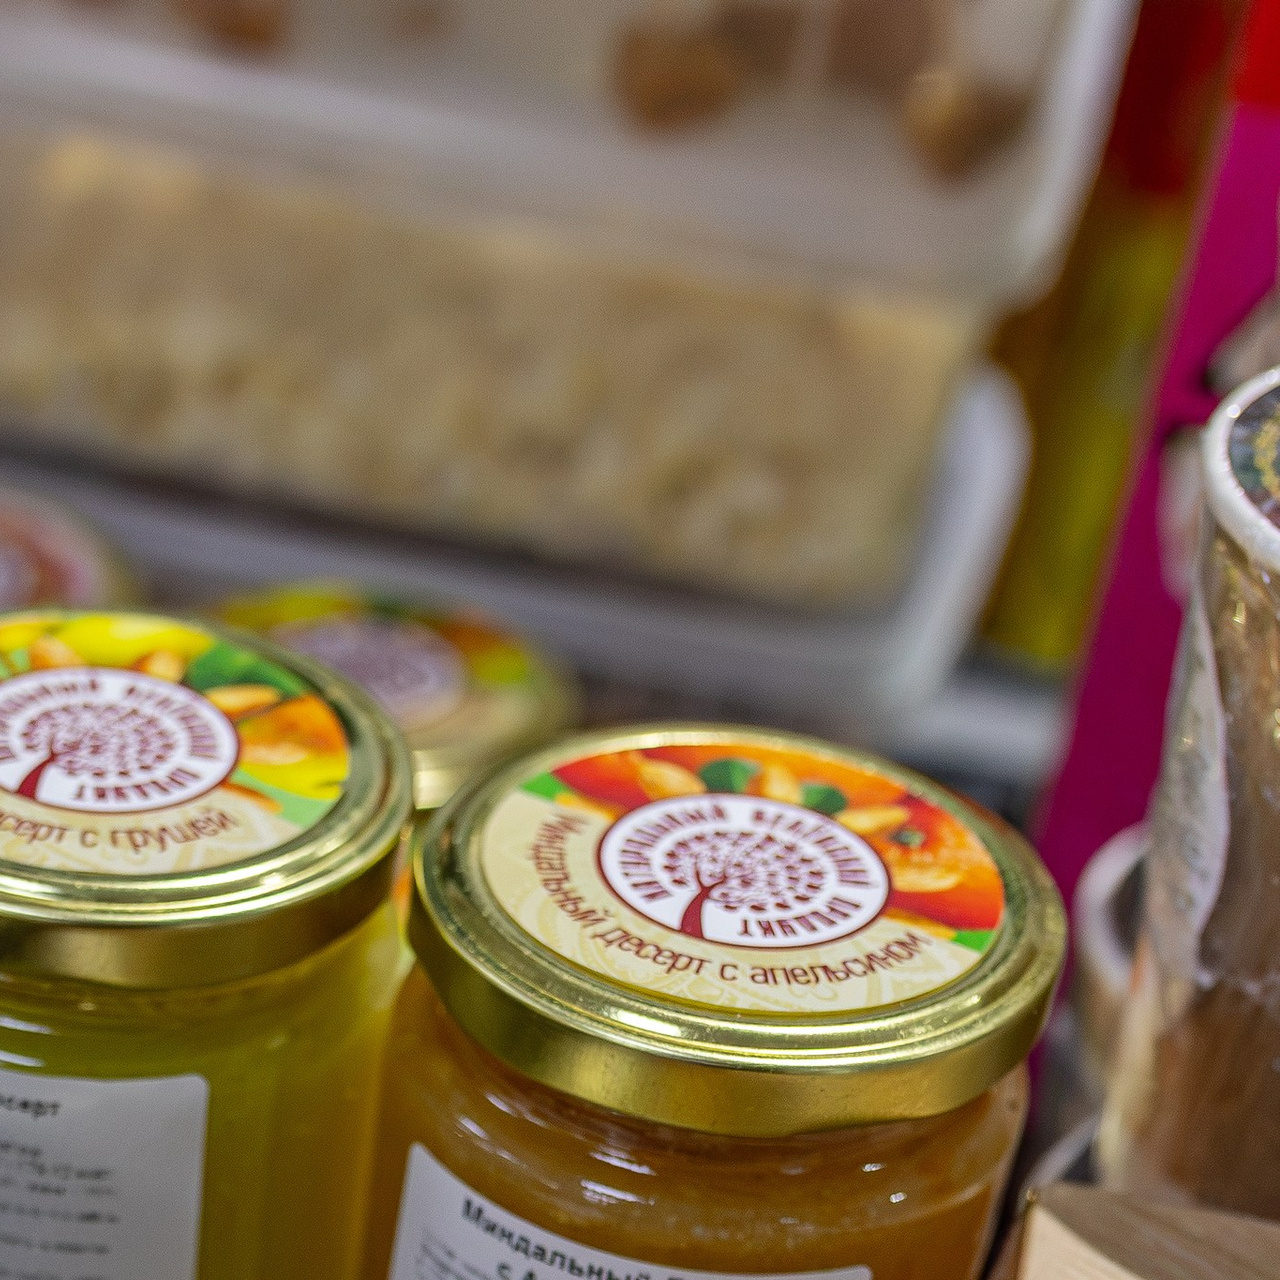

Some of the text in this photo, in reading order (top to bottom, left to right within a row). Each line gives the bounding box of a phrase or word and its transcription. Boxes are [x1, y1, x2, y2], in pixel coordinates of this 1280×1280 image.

[79, 829, 97, 848] с
[109, 806, 239, 855] грушей
[528, 811, 933, 987] Миндальный десерт с апельсином
[496, 1262, 512, 1280] с
